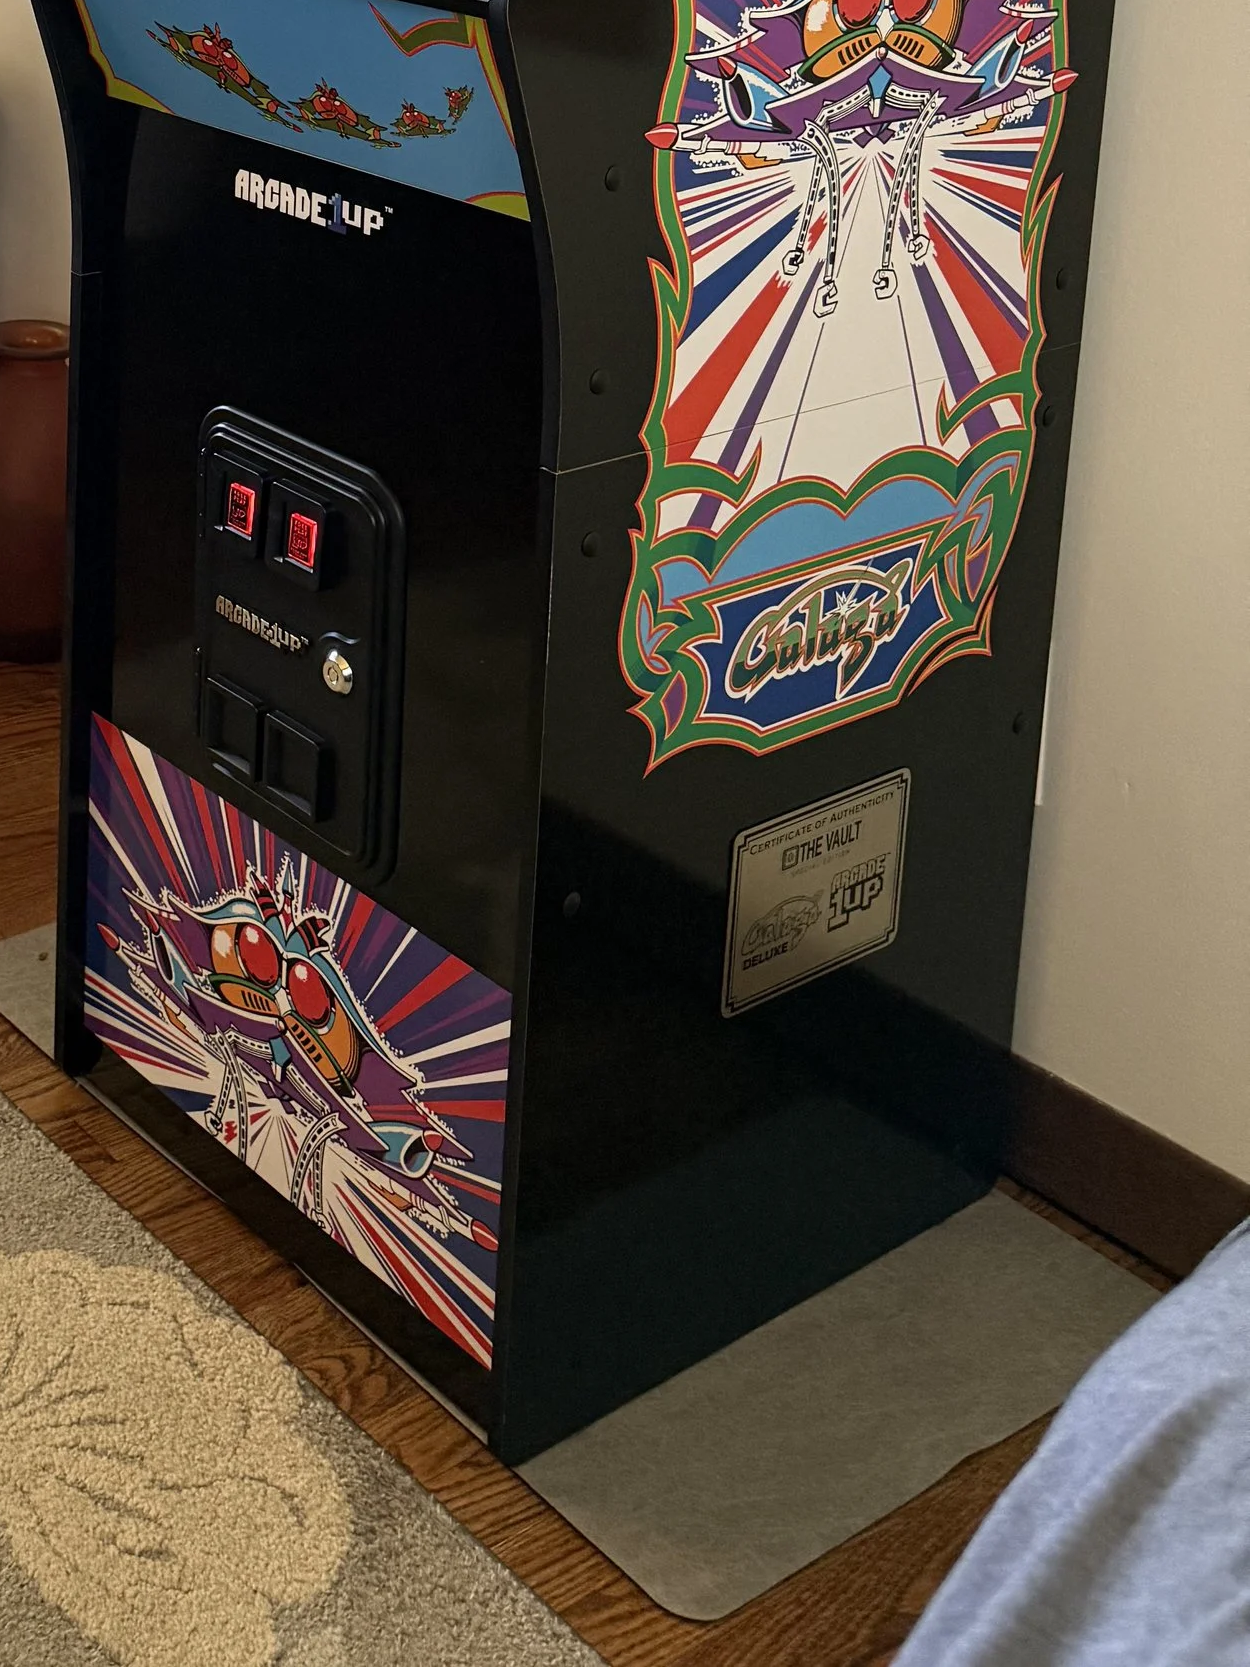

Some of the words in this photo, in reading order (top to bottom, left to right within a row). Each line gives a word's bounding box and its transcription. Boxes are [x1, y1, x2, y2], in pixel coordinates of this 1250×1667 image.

[750, 826, 813, 855] CERTIFICATE
[815, 818, 827, 830] OF
[830, 791, 895, 822] AUTHENTICITY
[800, 835, 823, 863] THE
[825, 820, 863, 853] VAULT
[831, 856, 887, 893] ARCADE
[742, 941, 788, 971] DELUXE
